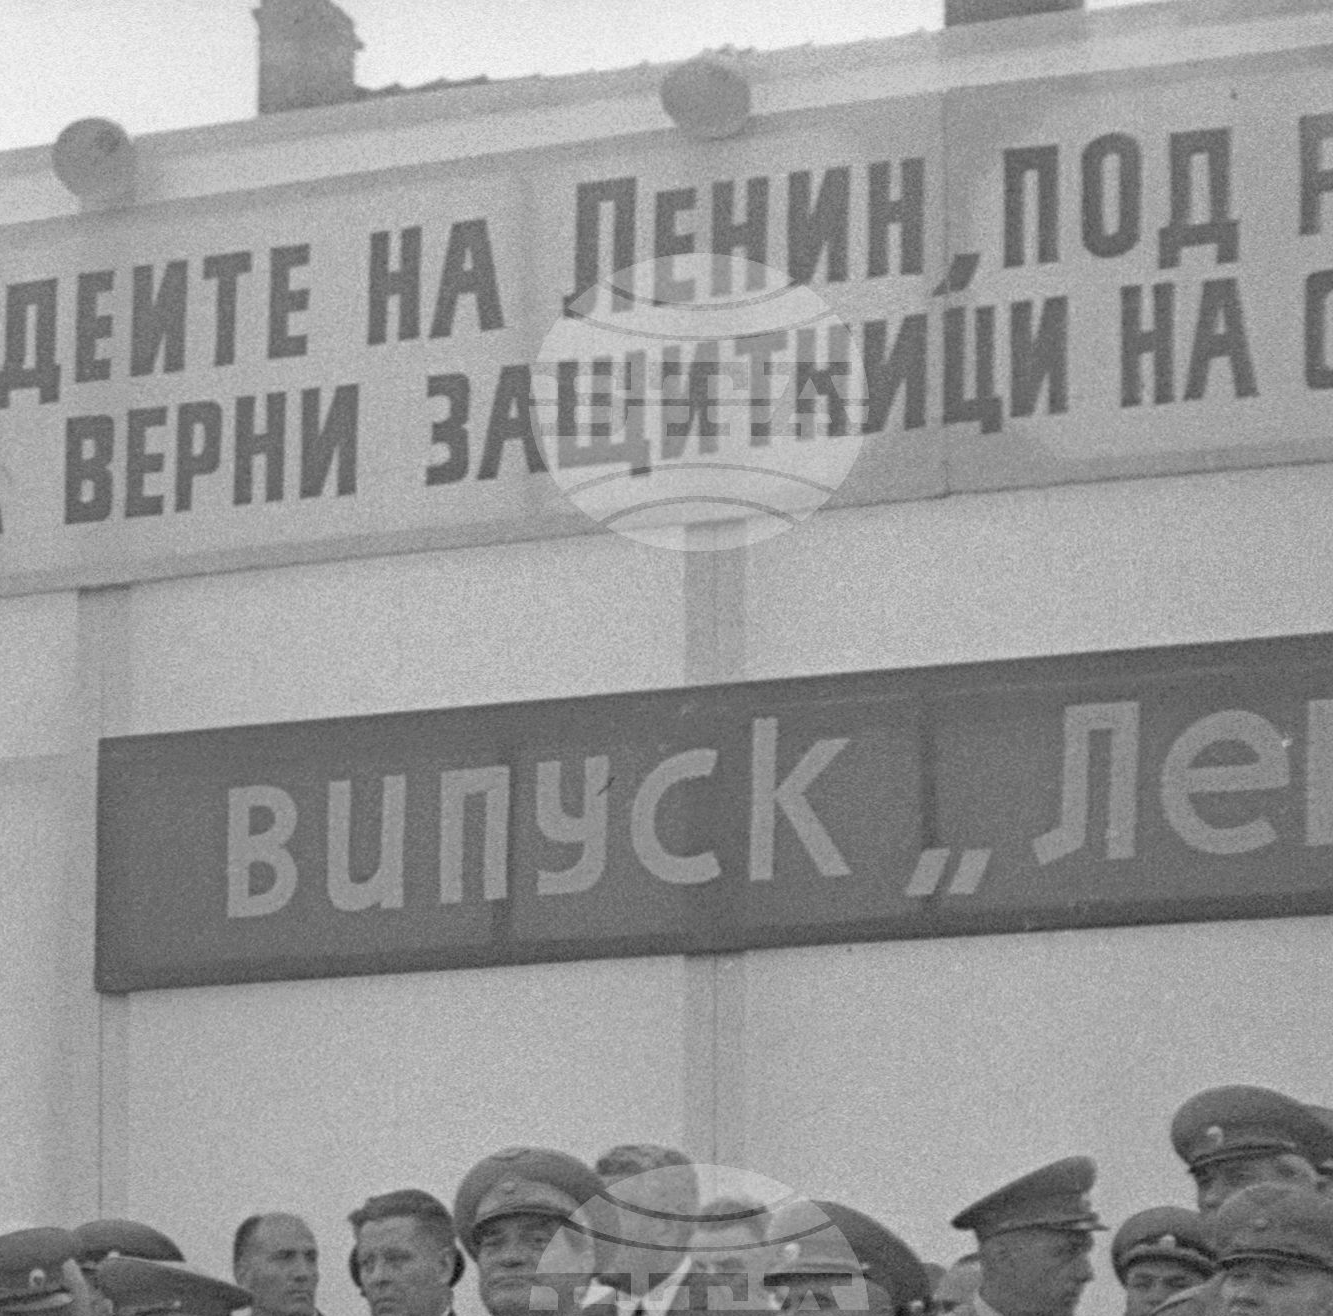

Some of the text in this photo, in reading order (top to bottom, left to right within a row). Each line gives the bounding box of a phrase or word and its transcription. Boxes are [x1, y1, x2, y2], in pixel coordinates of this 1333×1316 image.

[367, 217, 506, 346] НА
[1002, 126, 1240, 269] ПОД
[63, 383, 360, 525] ВЕРНИ
[424, 295, 1069, 486] ЗАЩИТНИЦИ
[1120, 276, 1260, 409] НА
